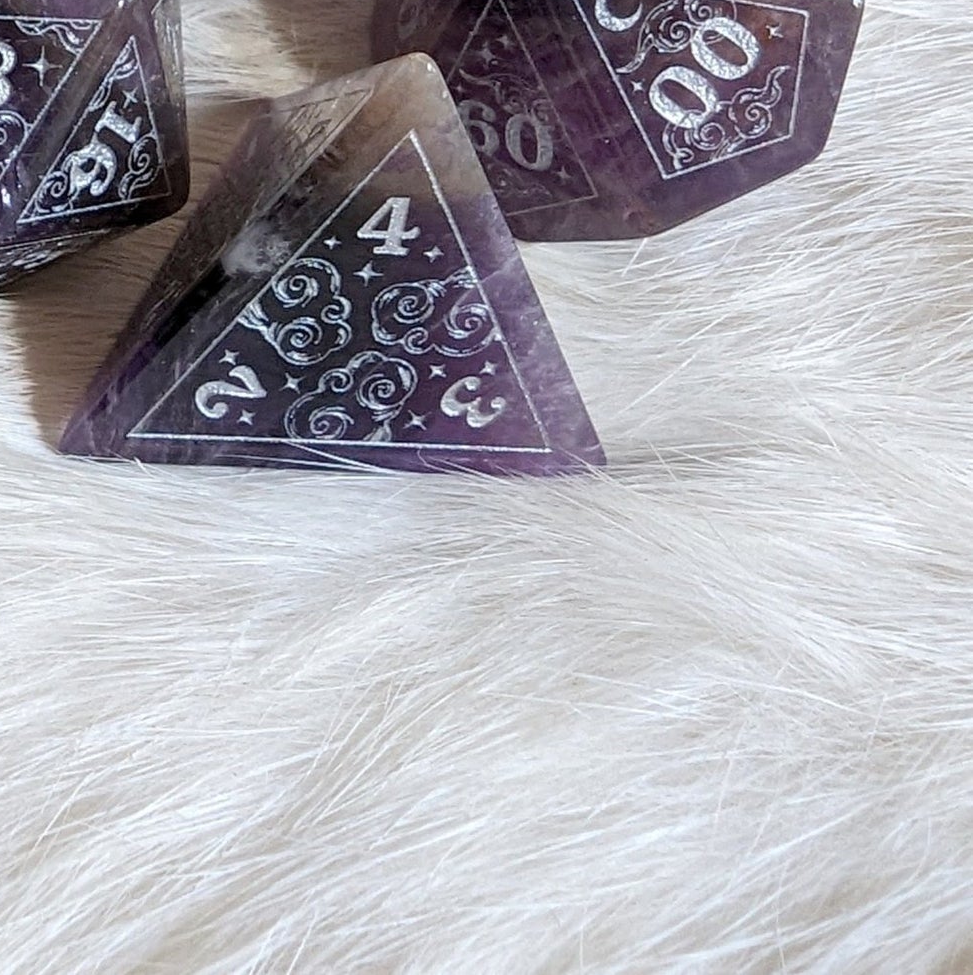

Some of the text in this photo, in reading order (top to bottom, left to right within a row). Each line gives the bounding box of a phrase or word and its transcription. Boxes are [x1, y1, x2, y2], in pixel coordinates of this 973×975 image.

[649, 16, 763, 127] 00
[457, 99, 553, 171] 60
[357, 196, 421, 256] 4
[194, 364, 268, 420] 2
[439, 376, 507, 428] 3
